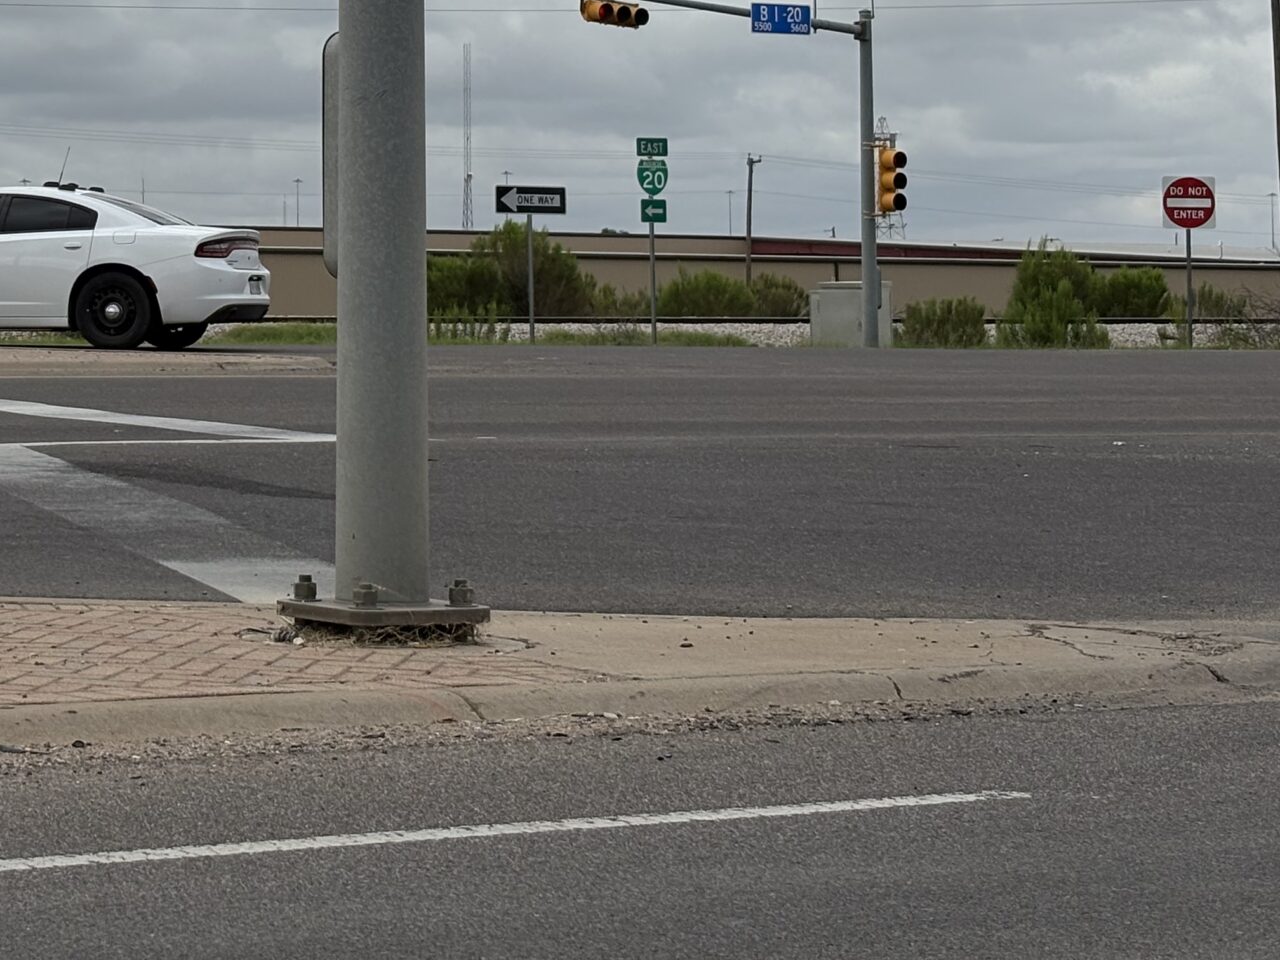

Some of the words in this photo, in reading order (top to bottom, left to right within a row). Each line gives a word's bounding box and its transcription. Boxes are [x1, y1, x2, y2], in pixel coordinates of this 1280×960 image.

[760, 5, 768, 21] B
[754, 21, 772, 32] 5500
[790, 23, 808, 33] 5600
[640, 141, 663, 154] EAST
[642, 171, 665, 189] 20
[1170, 186, 1184, 196] DO
[1188, 186, 1207, 196] NOT
[517, 195, 535, 205] ONE
[538, 195, 555, 205] WAY
[1173, 210, 1204, 219] ENTER
